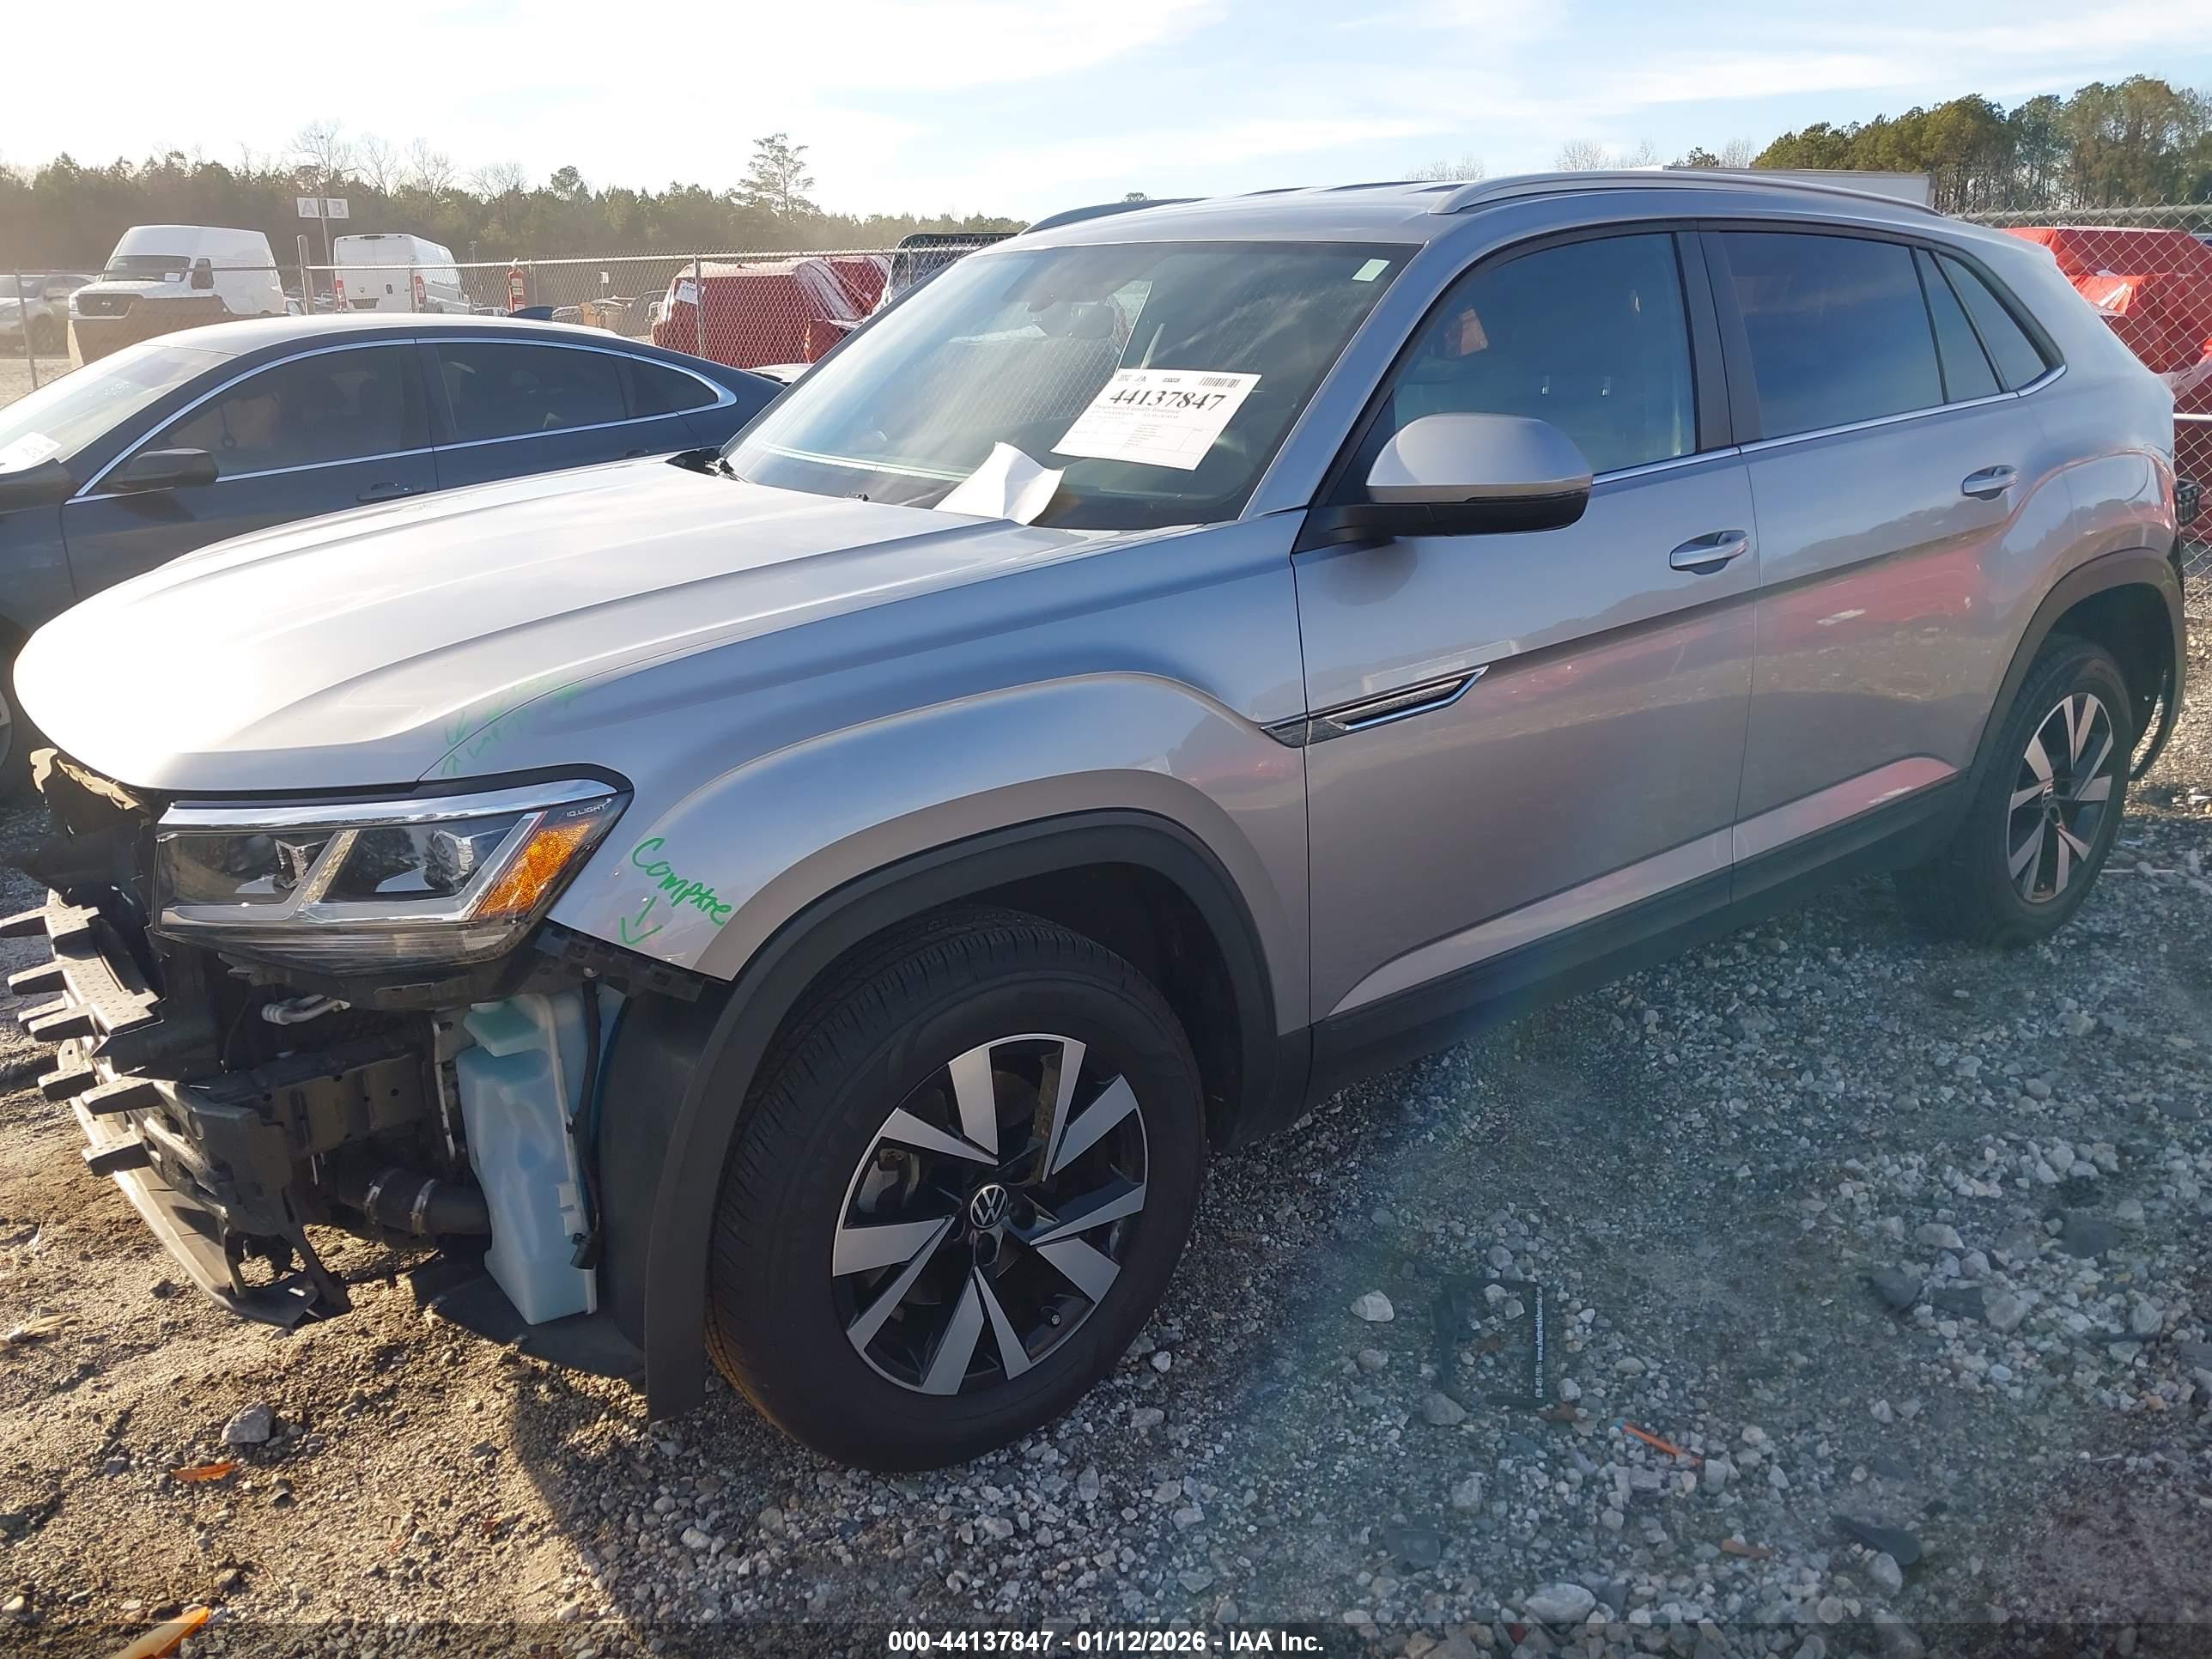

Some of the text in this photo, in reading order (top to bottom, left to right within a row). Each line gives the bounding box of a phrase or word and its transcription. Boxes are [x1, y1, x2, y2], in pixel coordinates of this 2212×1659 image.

[301, 200, 317, 216] A
[1109, 388, 1226, 411] 44137847
[567, 803, 605, 817] IQ.LIGHT
